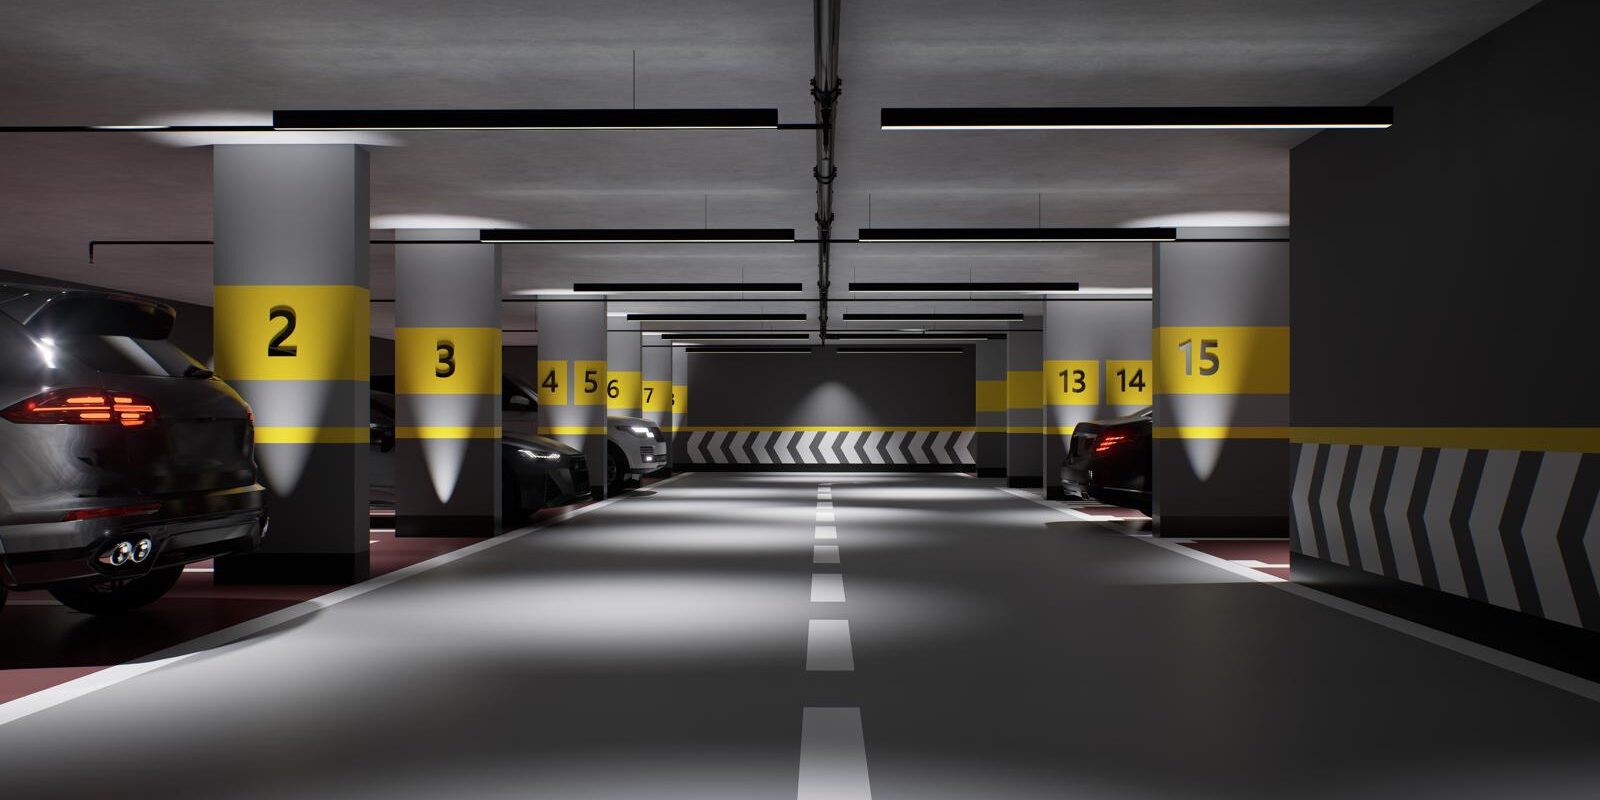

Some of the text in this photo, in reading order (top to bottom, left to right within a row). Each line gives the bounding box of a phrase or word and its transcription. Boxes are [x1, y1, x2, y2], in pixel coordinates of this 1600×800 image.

[268, 305, 297, 357] 2
[435, 340, 456, 378] 3
[1178, 339, 1220, 376] 15
[542, 370, 558, 393] 4
[584, 370, 598, 393] 5
[607, 379, 620, 399] 6
[1058, 370, 1087, 393] 13
[1116, 369, 1146, 392] 14
[644, 387, 654, 403] 7
